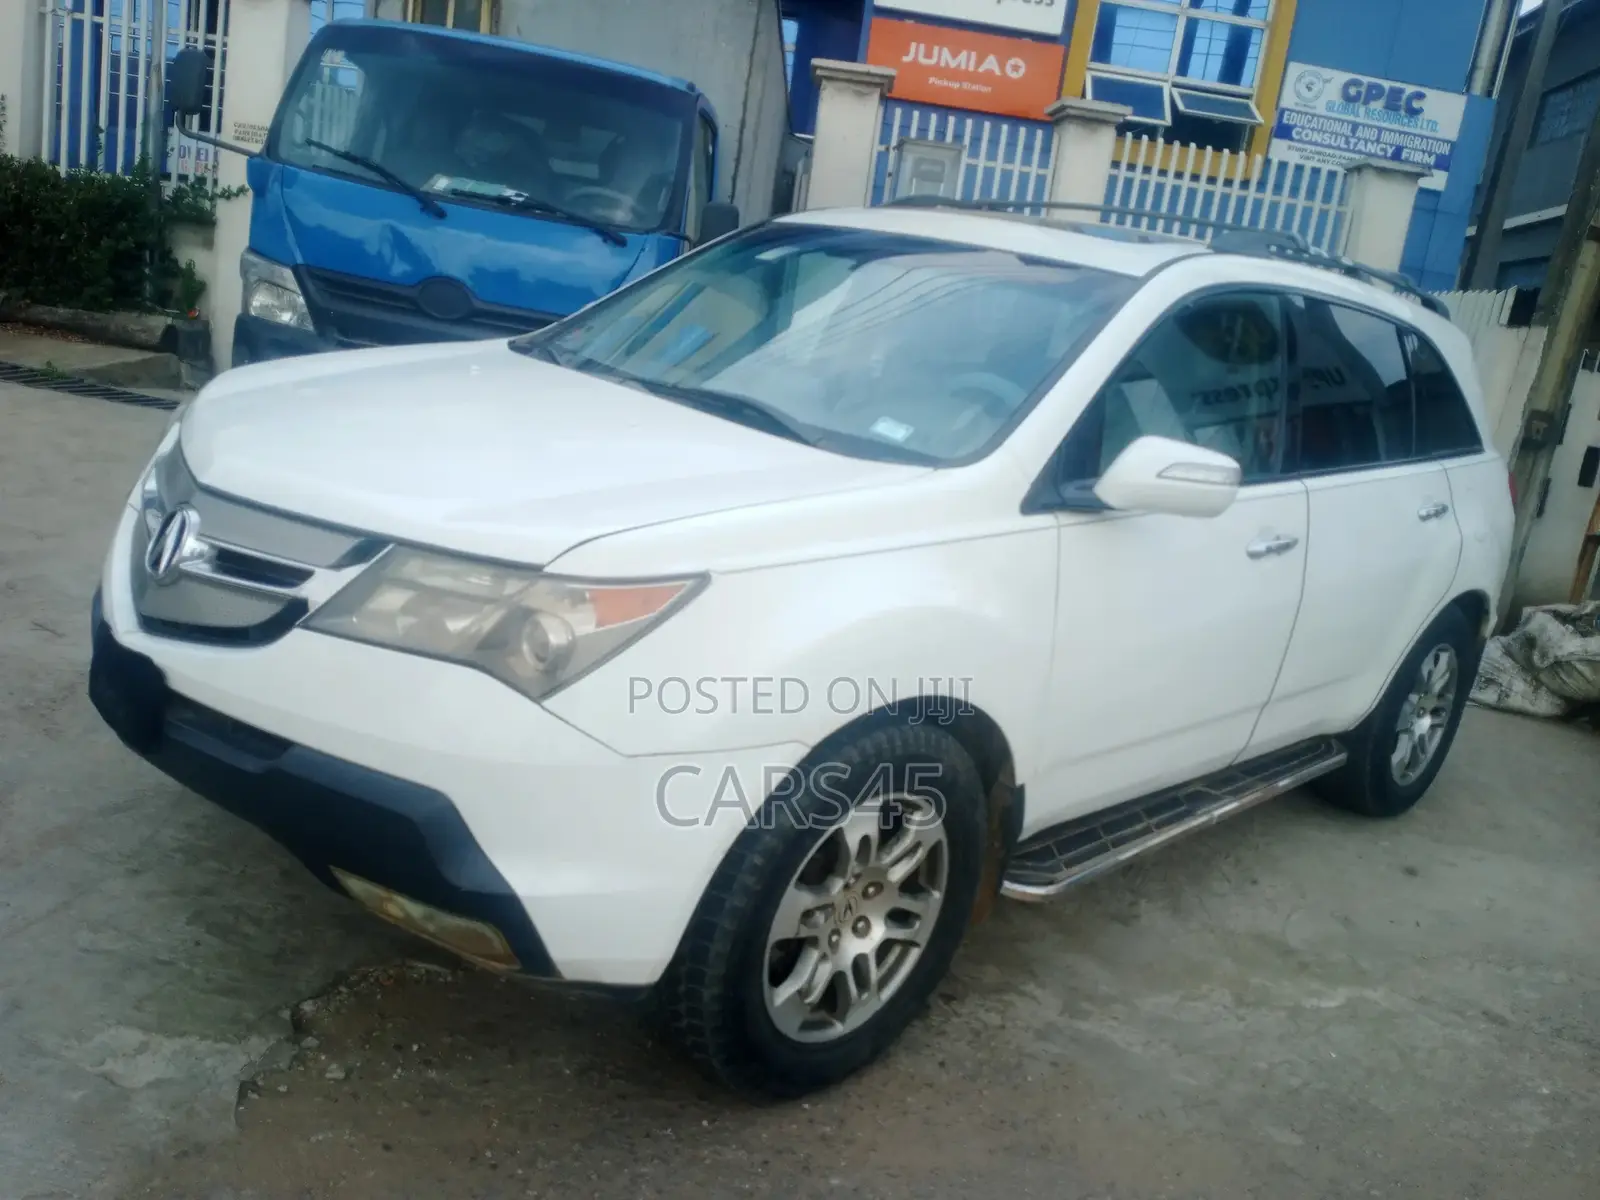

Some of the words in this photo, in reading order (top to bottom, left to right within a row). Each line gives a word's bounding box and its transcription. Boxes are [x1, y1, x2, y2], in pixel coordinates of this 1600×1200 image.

[902, 41, 1002, 76] JUMIA
[928, 76, 960, 90] Pickup
[962, 80, 992, 93] Station
[1342, 77, 1427, 116] GPEC
[1282, 110, 1352, 137] EDUCATIONAL
[1355, 125, 1378, 141] AND
[1380, 130, 1451, 155] IMMIGRATION
[1325, 100, 1361, 118] GLOBAL
[1364, 106, 1420, 129] RESOURCES
[1292, 127, 1395, 157] CONSULTANCY
[1401, 148, 1437, 166] FIRM
